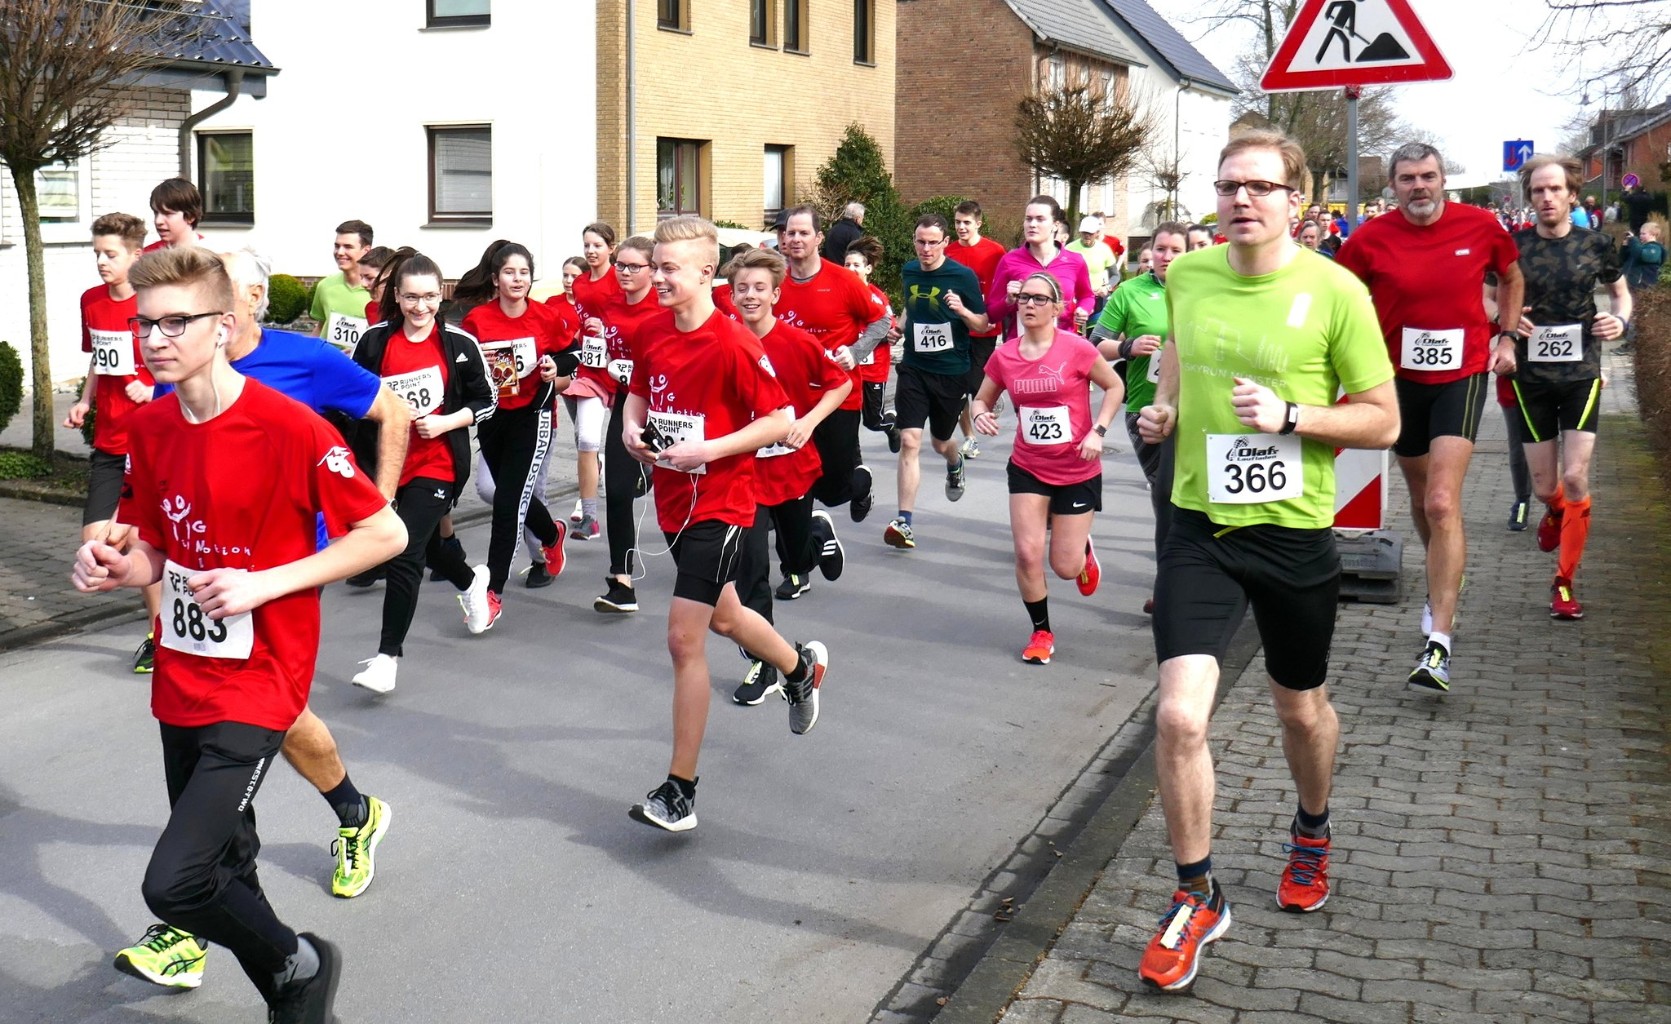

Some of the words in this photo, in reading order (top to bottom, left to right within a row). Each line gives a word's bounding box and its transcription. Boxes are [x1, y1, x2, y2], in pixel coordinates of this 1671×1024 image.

[334, 327, 359, 344] 310
[921, 335, 946, 348] 416
[1412, 347, 1452, 365] 385
[1538, 340, 1572, 357] 262
[1014, 376, 1057, 394] PUMA
[397, 388, 431, 409] 68
[658, 418, 693, 429] RUNNERS
[658, 425, 680, 434] POINT
[1030, 423, 1062, 439] 423
[535, 408, 552, 460] URBAN
[1224, 460, 1286, 494] 366
[173, 597, 227, 643] 883
